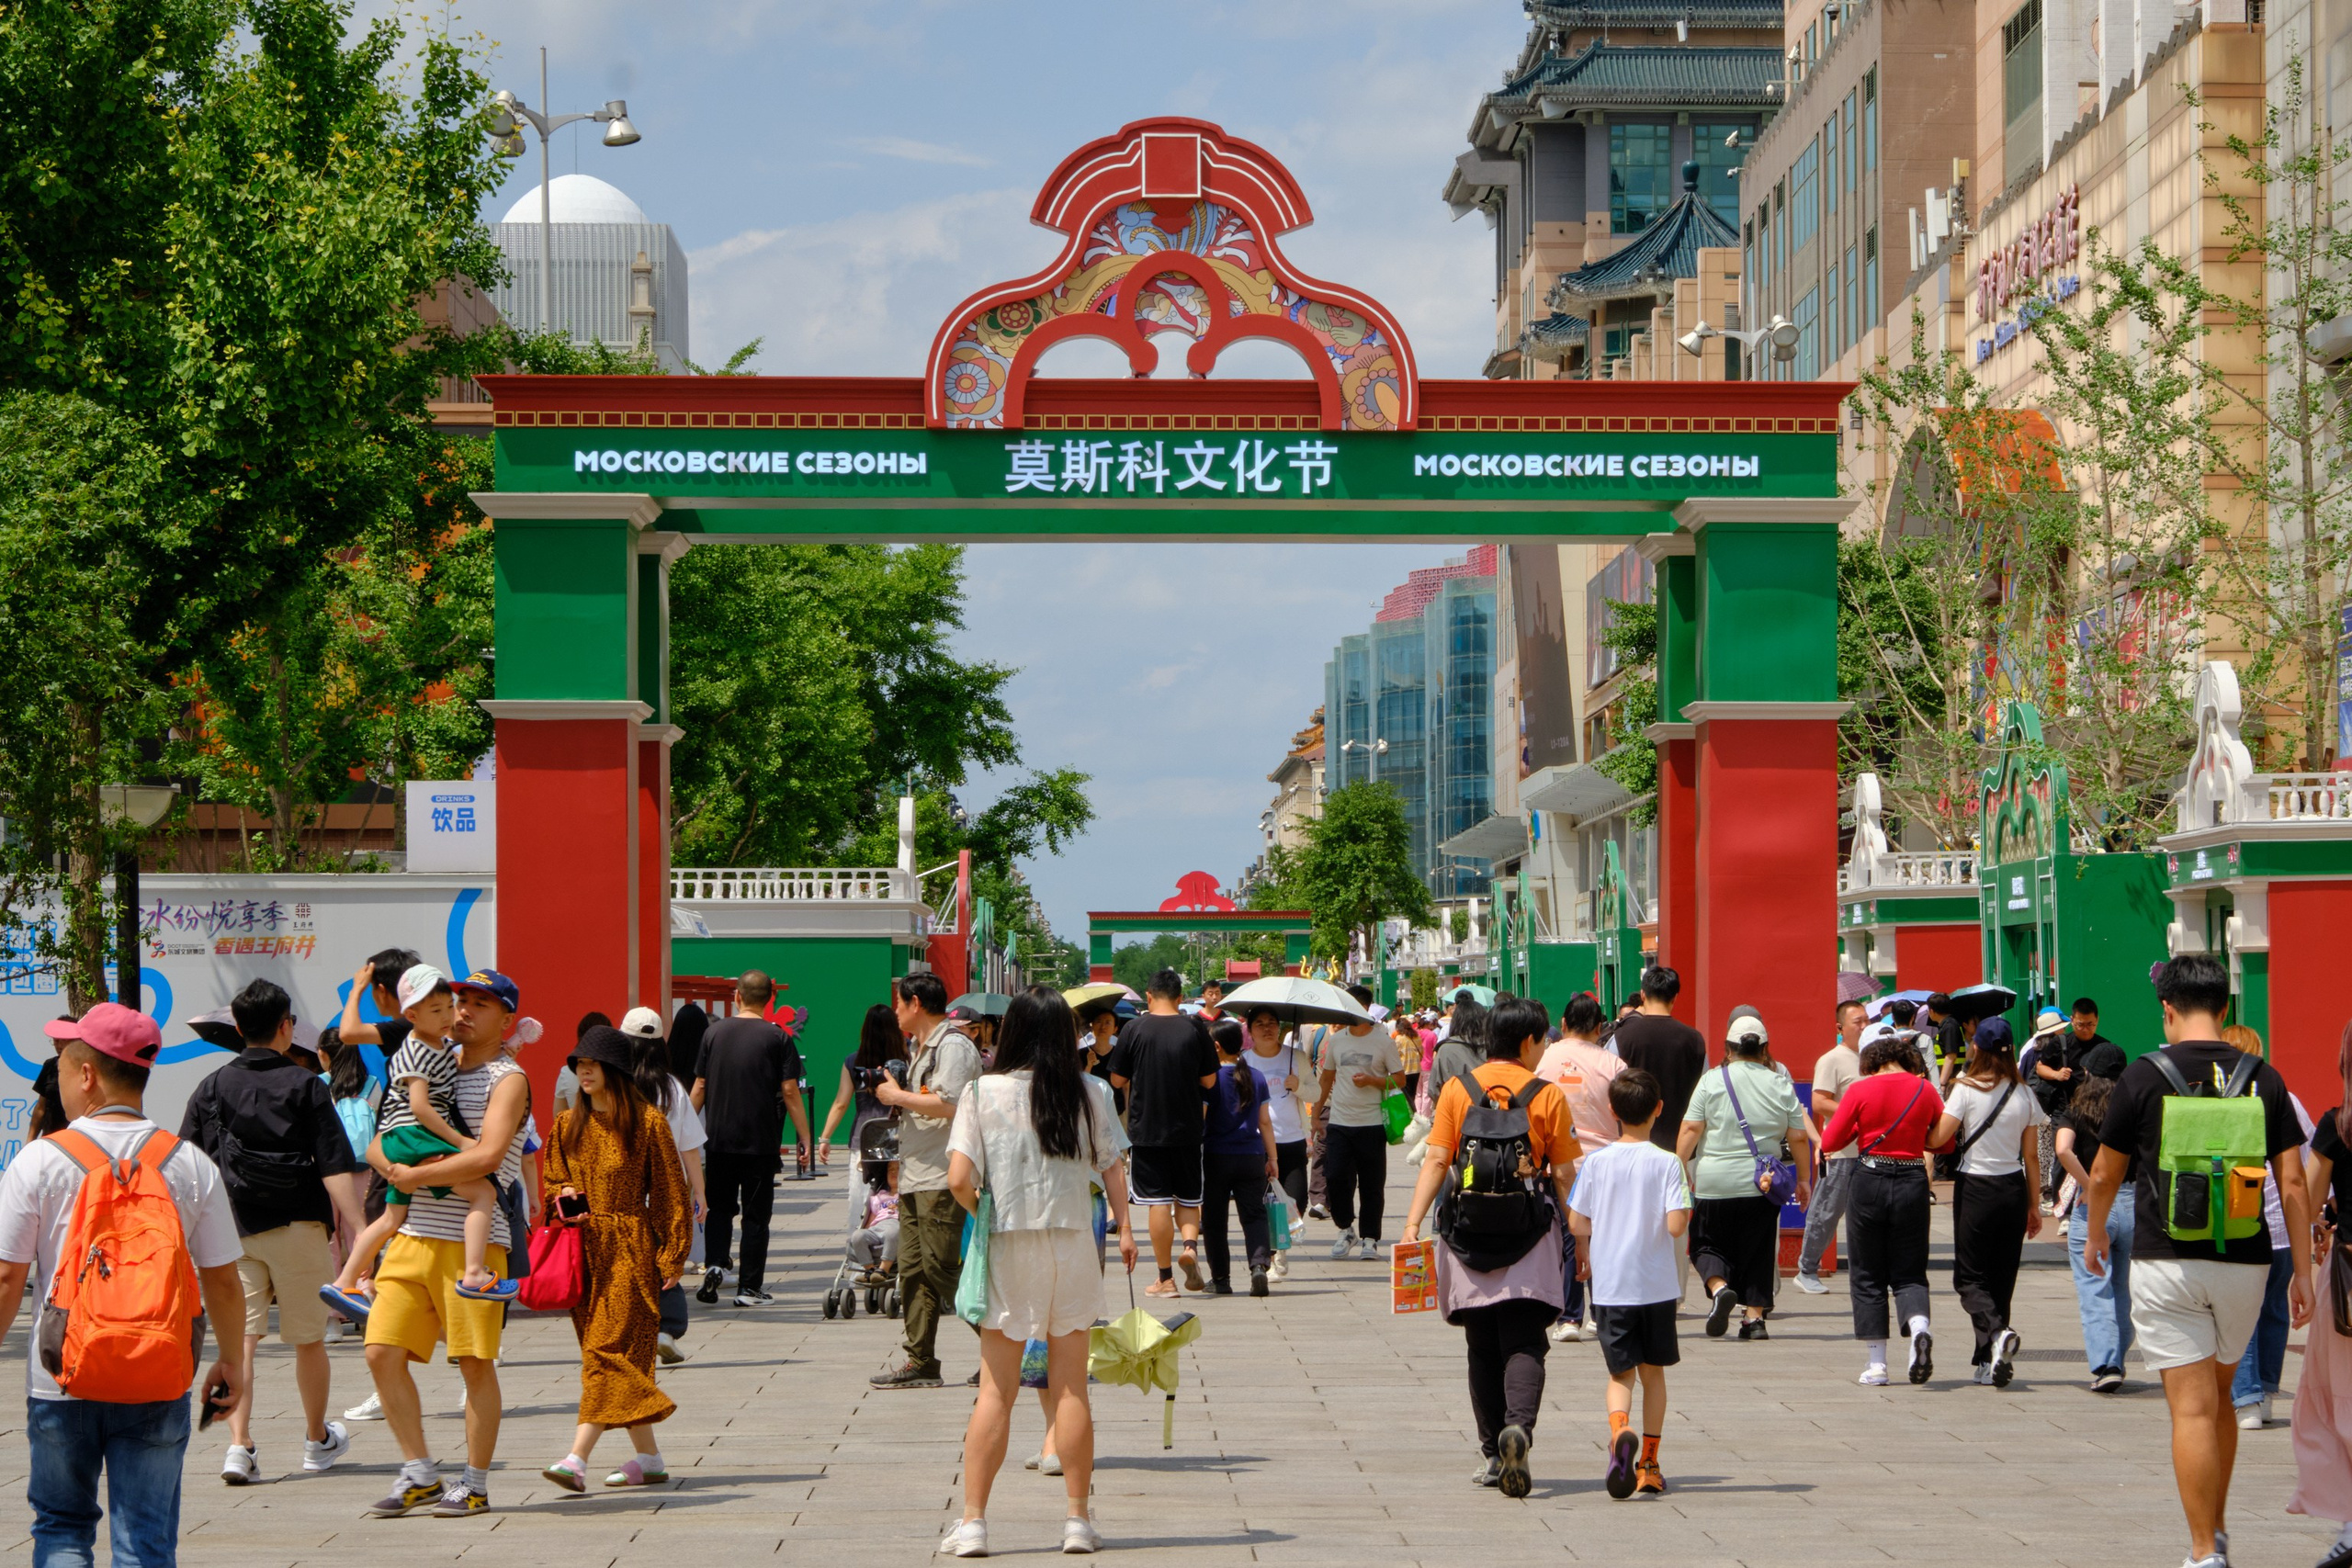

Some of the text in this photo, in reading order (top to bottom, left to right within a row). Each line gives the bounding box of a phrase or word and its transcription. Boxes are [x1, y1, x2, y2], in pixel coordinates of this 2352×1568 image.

[574, 450, 928, 475] МОСКОВСКИЕ СЕЗОНЫ
[1004, 439, 1339, 494] 莫斯科文化节
[1413, 454, 1759, 478] МОСКОВСКИЕ СЕЗОНЫ
[431, 807, 476, 832] 饮品
[213, 934, 318, 961] 香遇王府井
